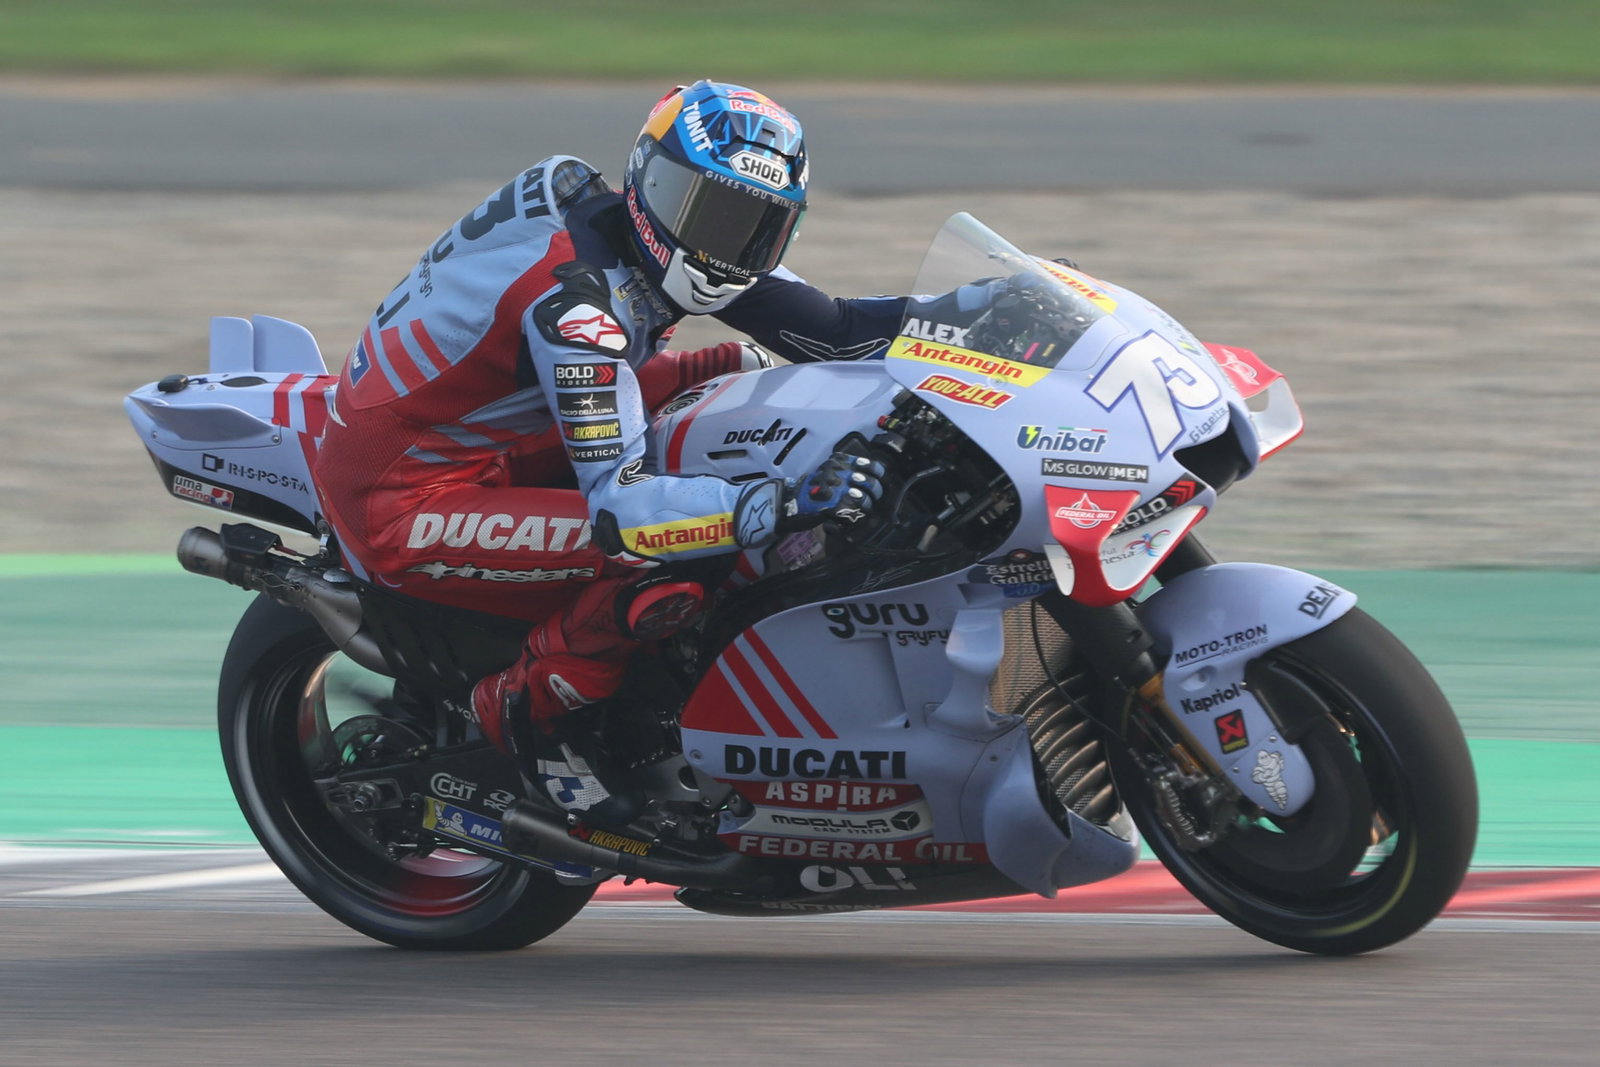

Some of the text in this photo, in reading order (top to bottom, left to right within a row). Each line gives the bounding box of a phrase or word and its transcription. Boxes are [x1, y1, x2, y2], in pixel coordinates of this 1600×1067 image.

[729, 99, 766, 115] Red
[705, 170, 740, 191] GIVES
[745, 183, 768, 200] YOU
[740, 156, 783, 185] SHOEI
[626, 184, 648, 229] Red
[639, 222, 671, 269] Bull
[708, 256, 752, 277] VERTICAL
[901, 317, 971, 347] ALEX
[556, 366, 594, 379] BOLD
[903, 342, 1023, 379] Antangin
[925, 375, 1007, 407] YOU-ALL
[1084, 328, 1223, 462] 73
[723, 419, 794, 446] DUCATI
[1017, 425, 1107, 453] Unibat
[1189, 406, 1228, 444] Gigetta
[575, 448, 621, 458] VERTICAL
[175, 475, 203, 492] uma
[228, 462, 309, 495] RISPOSTA
[1043, 459, 1064, 473] MS
[1065, 464, 1109, 476] GLOW
[1113, 469, 1147, 480] MEN
[173, 485, 212, 501] racing
[1059, 509, 1096, 518] FEDERAL
[407, 513, 592, 552] DUCATI
[820, 602, 930, 640] guru
[1174, 624, 1268, 664] MOTO-TRON
[1220, 637, 1269, 657] RACING
[1181, 683, 1242, 714] Kapriol
[724, 744, 907, 780] DUCATI
[431, 772, 477, 801] CHT
[771, 815, 888, 829] MODULA
[738, 835, 974, 863] FEDERAL OIL
